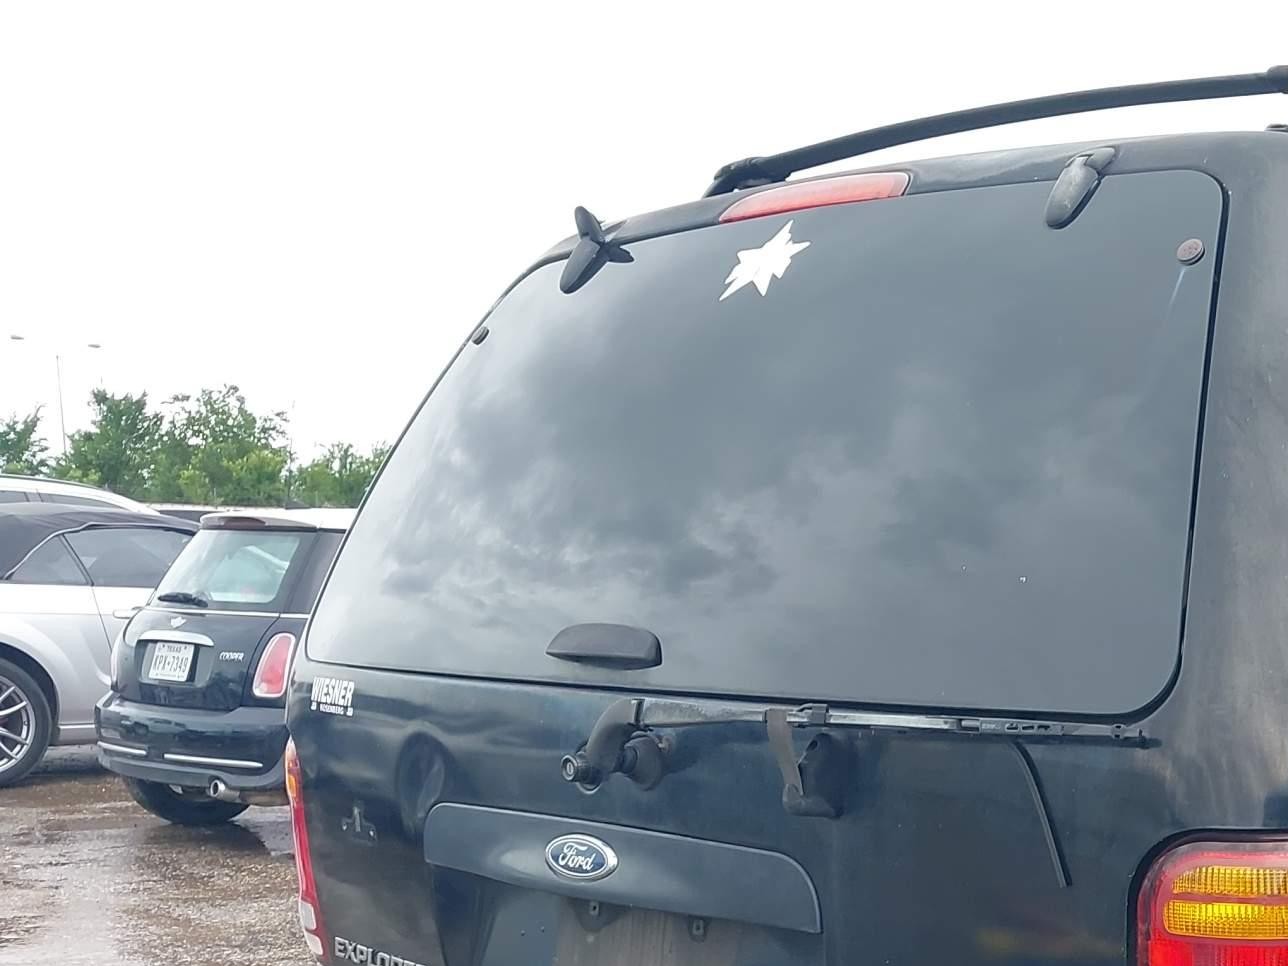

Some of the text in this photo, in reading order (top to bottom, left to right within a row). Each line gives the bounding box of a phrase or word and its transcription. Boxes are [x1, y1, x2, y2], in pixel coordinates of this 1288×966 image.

[219, 651, 244, 662] COOPER
[311, 676, 355, 706] WIESNER
[558, 842, 597, 871] Ford
